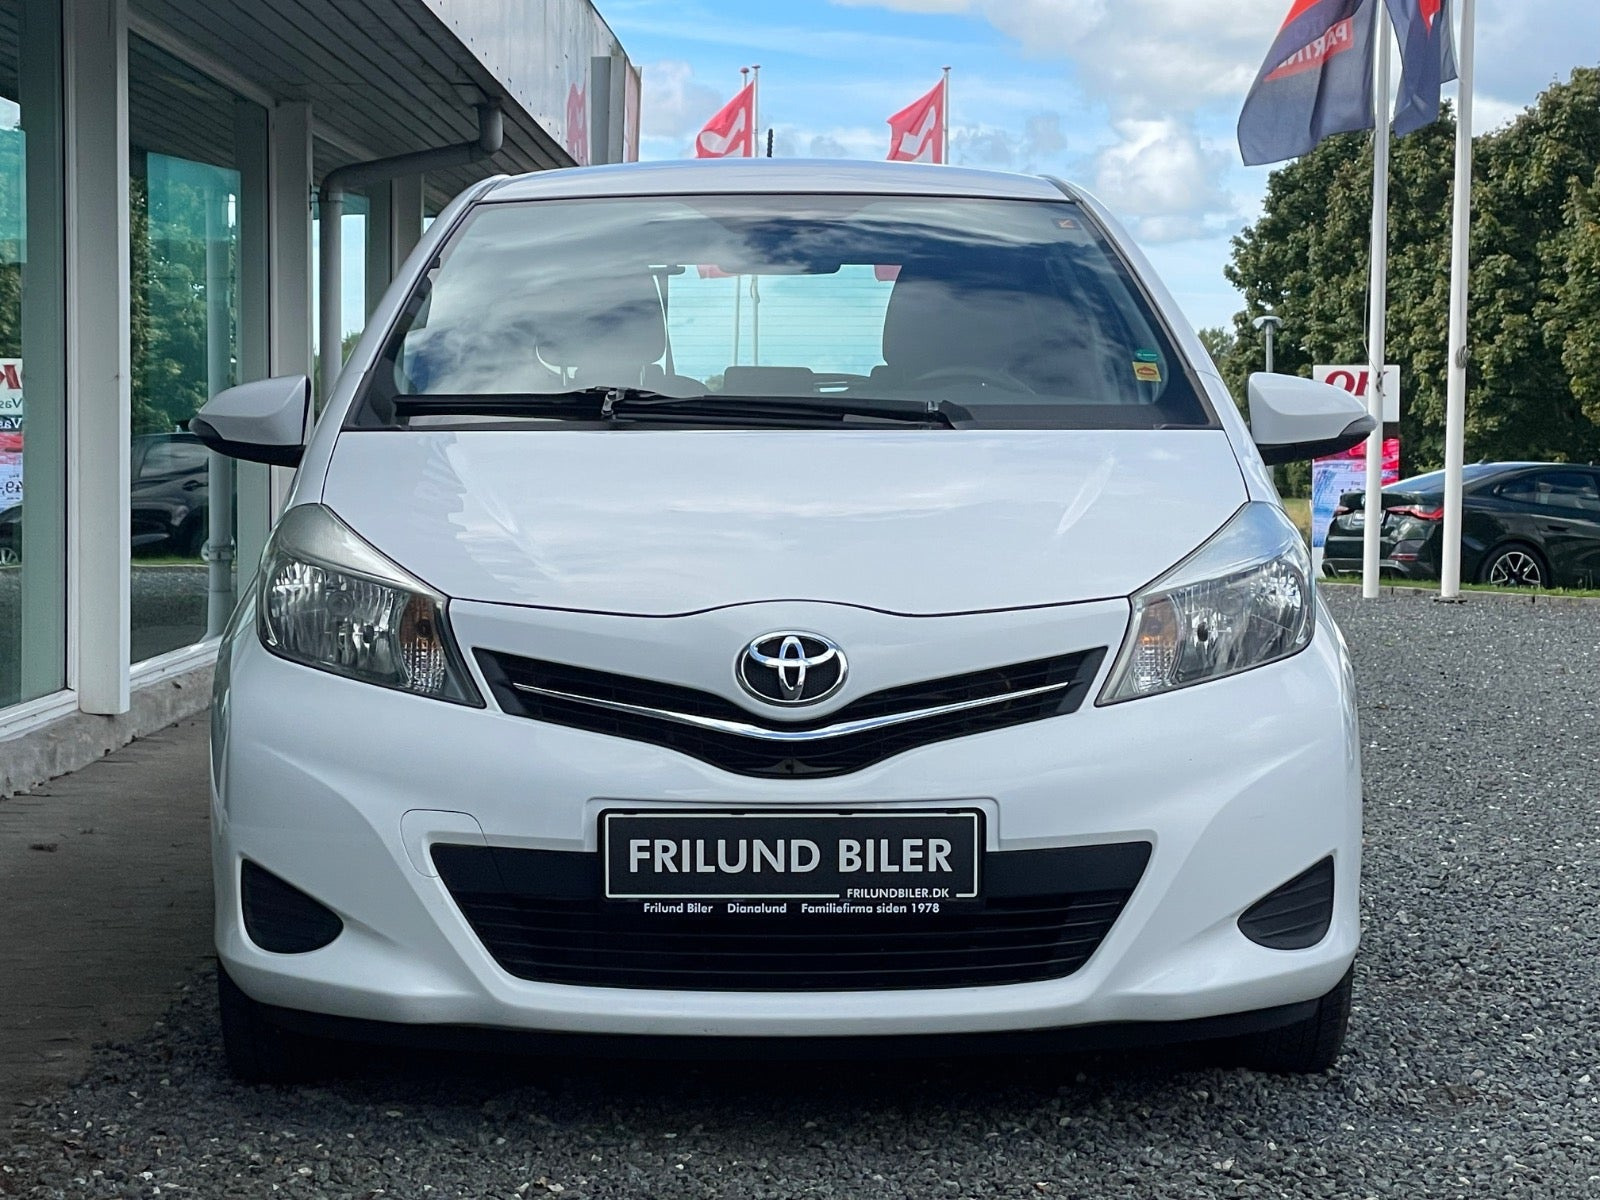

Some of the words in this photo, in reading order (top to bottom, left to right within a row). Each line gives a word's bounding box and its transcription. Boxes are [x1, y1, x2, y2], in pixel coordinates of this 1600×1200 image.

[629, 839, 821, 874] FRILUND
[838, 838, 953, 873] BILER
[847, 887, 950, 899] FRILUNDBILER.DK
[643, 902, 684, 914] Frilund
[687, 902, 714, 914] Biler
[727, 902, 787, 914] Dianalund
[801, 902, 873, 914] Familiefirma
[876, 902, 907, 914] siden
[911, 902, 940, 914] 1978
